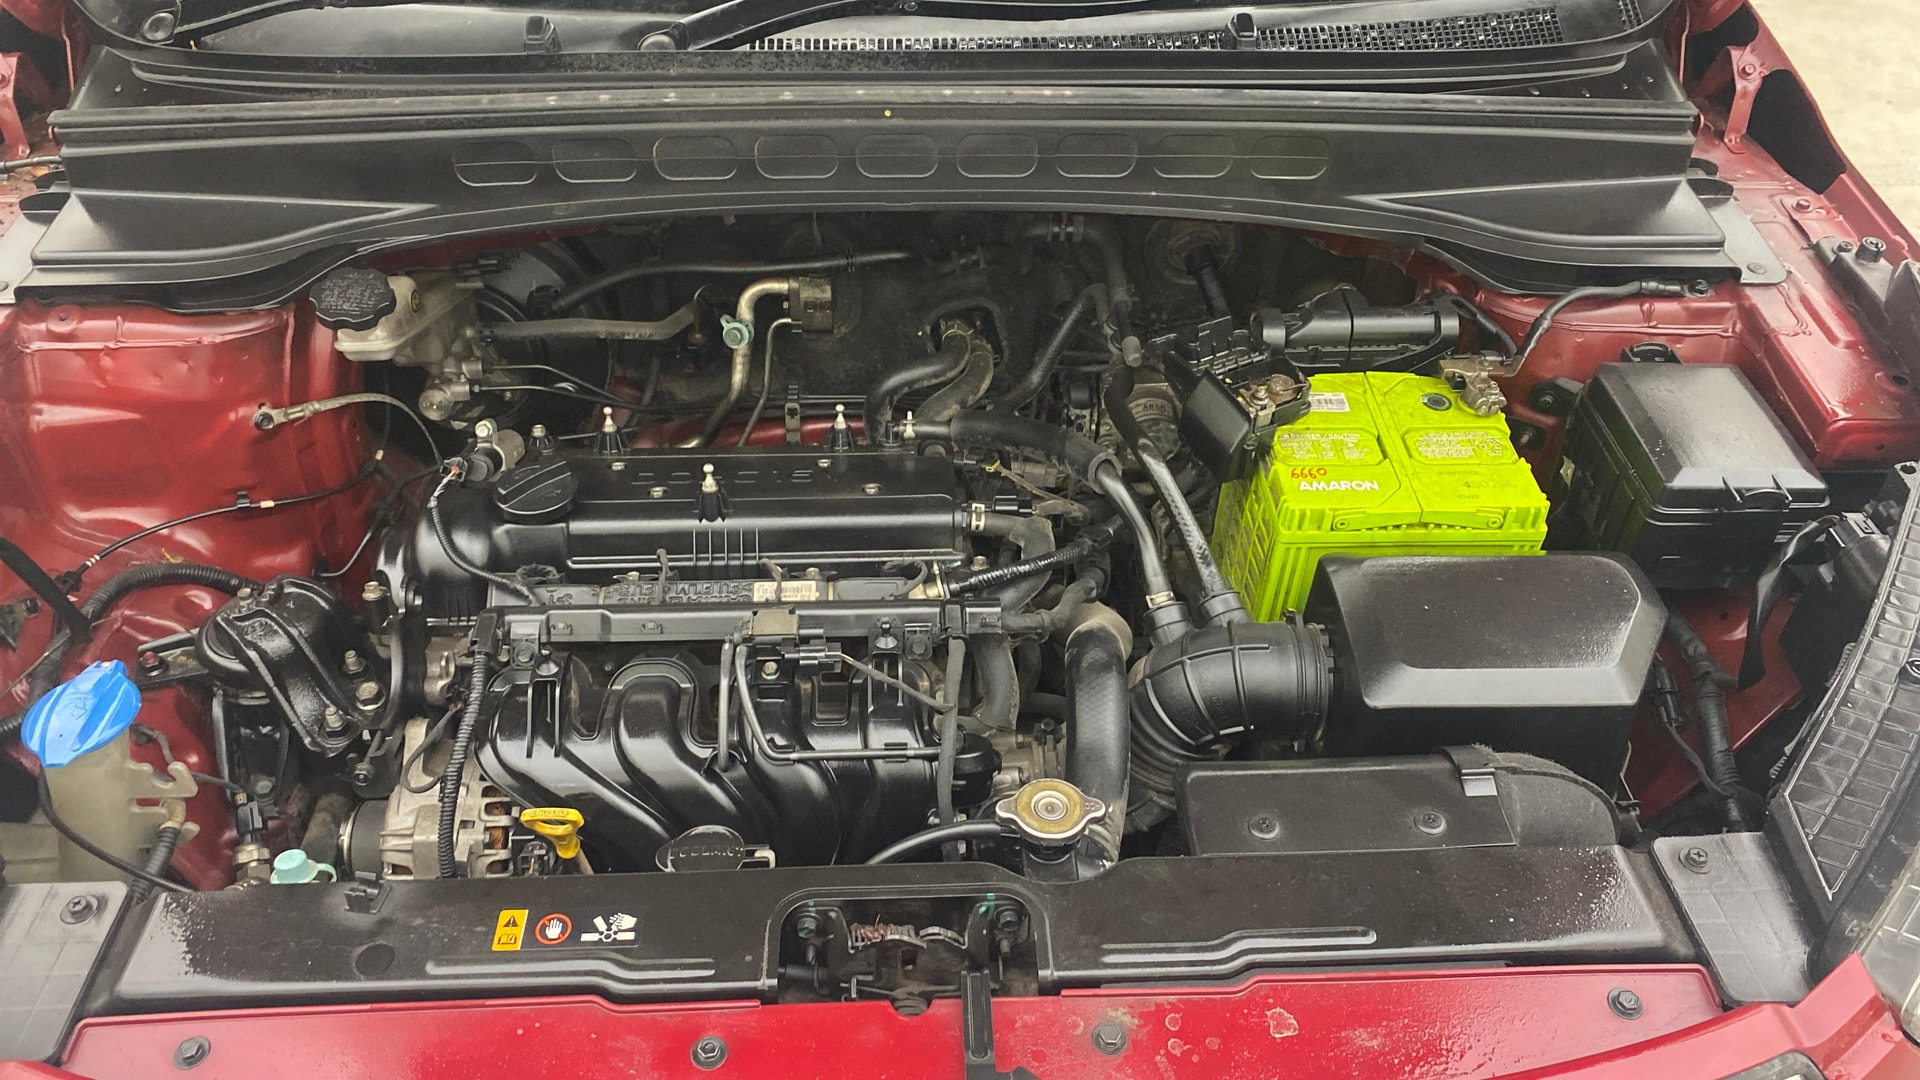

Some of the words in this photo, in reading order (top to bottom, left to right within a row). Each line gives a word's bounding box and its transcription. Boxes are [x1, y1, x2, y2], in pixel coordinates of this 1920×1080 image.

[1291, 467, 1327, 479] 6660
[1299, 480, 1379, 491] AMARON
[529, 808, 549, 817] ENG
